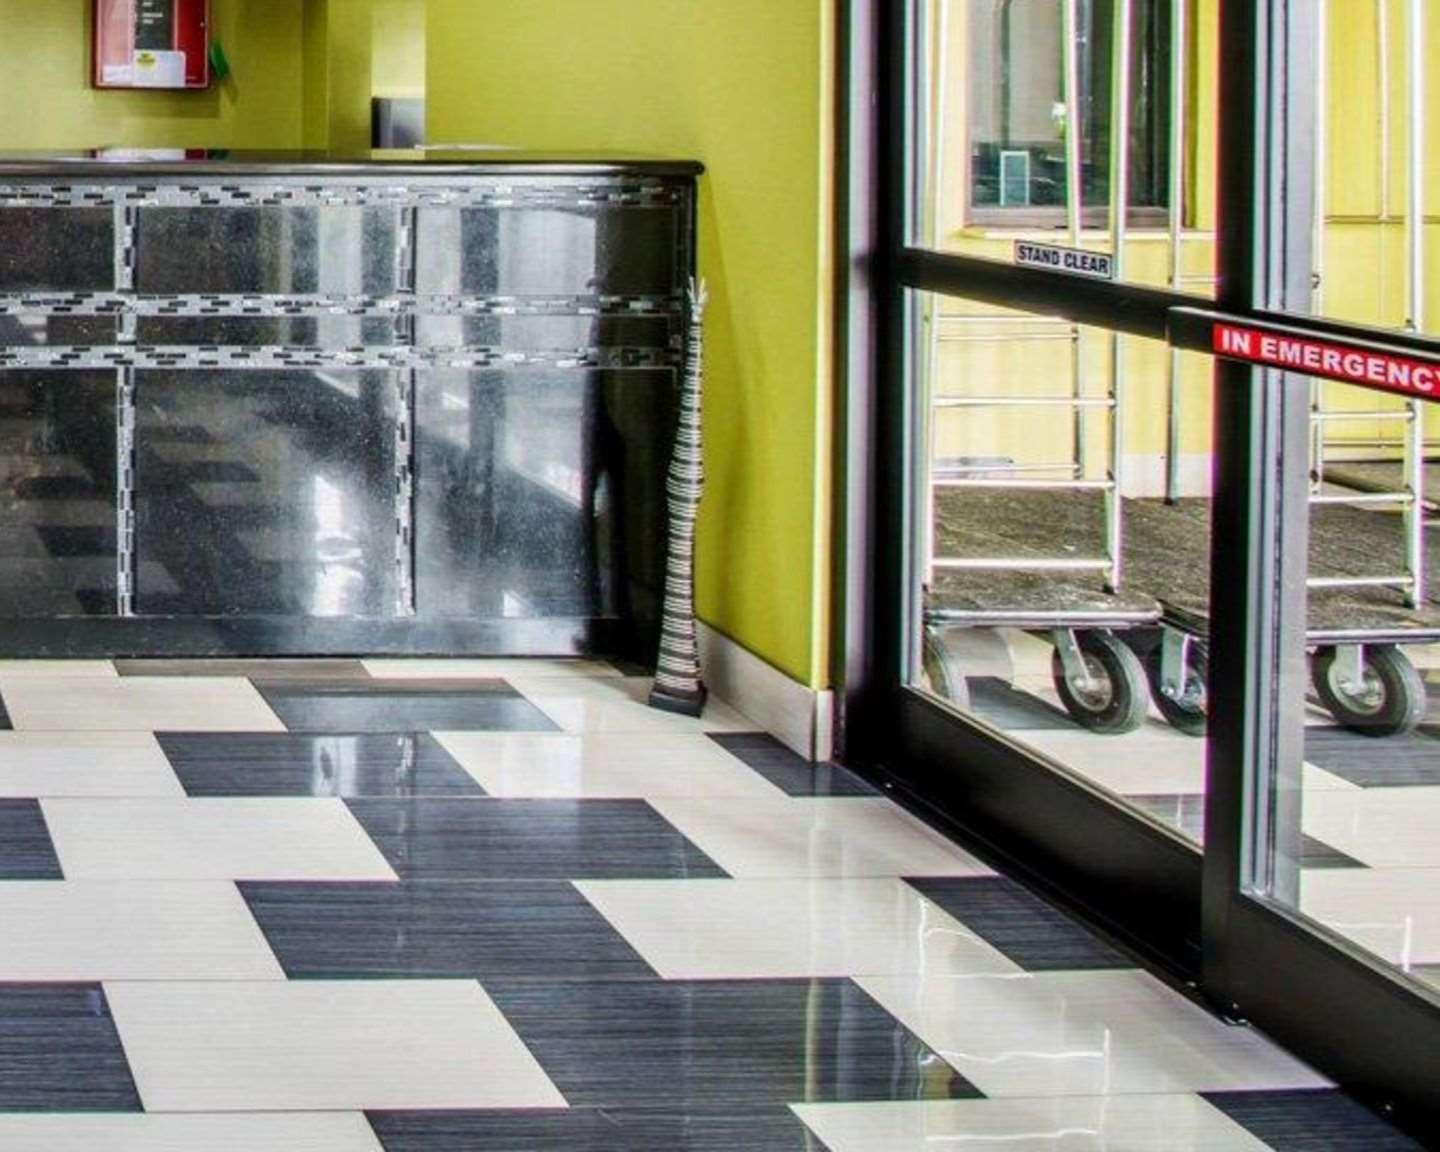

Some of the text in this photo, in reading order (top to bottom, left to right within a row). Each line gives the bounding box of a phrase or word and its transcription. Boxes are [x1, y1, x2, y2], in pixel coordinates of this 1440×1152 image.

[1018, 245, 1109, 274] STAND CLEAR
[1221, 328, 1440, 392] IN EMERGENC
